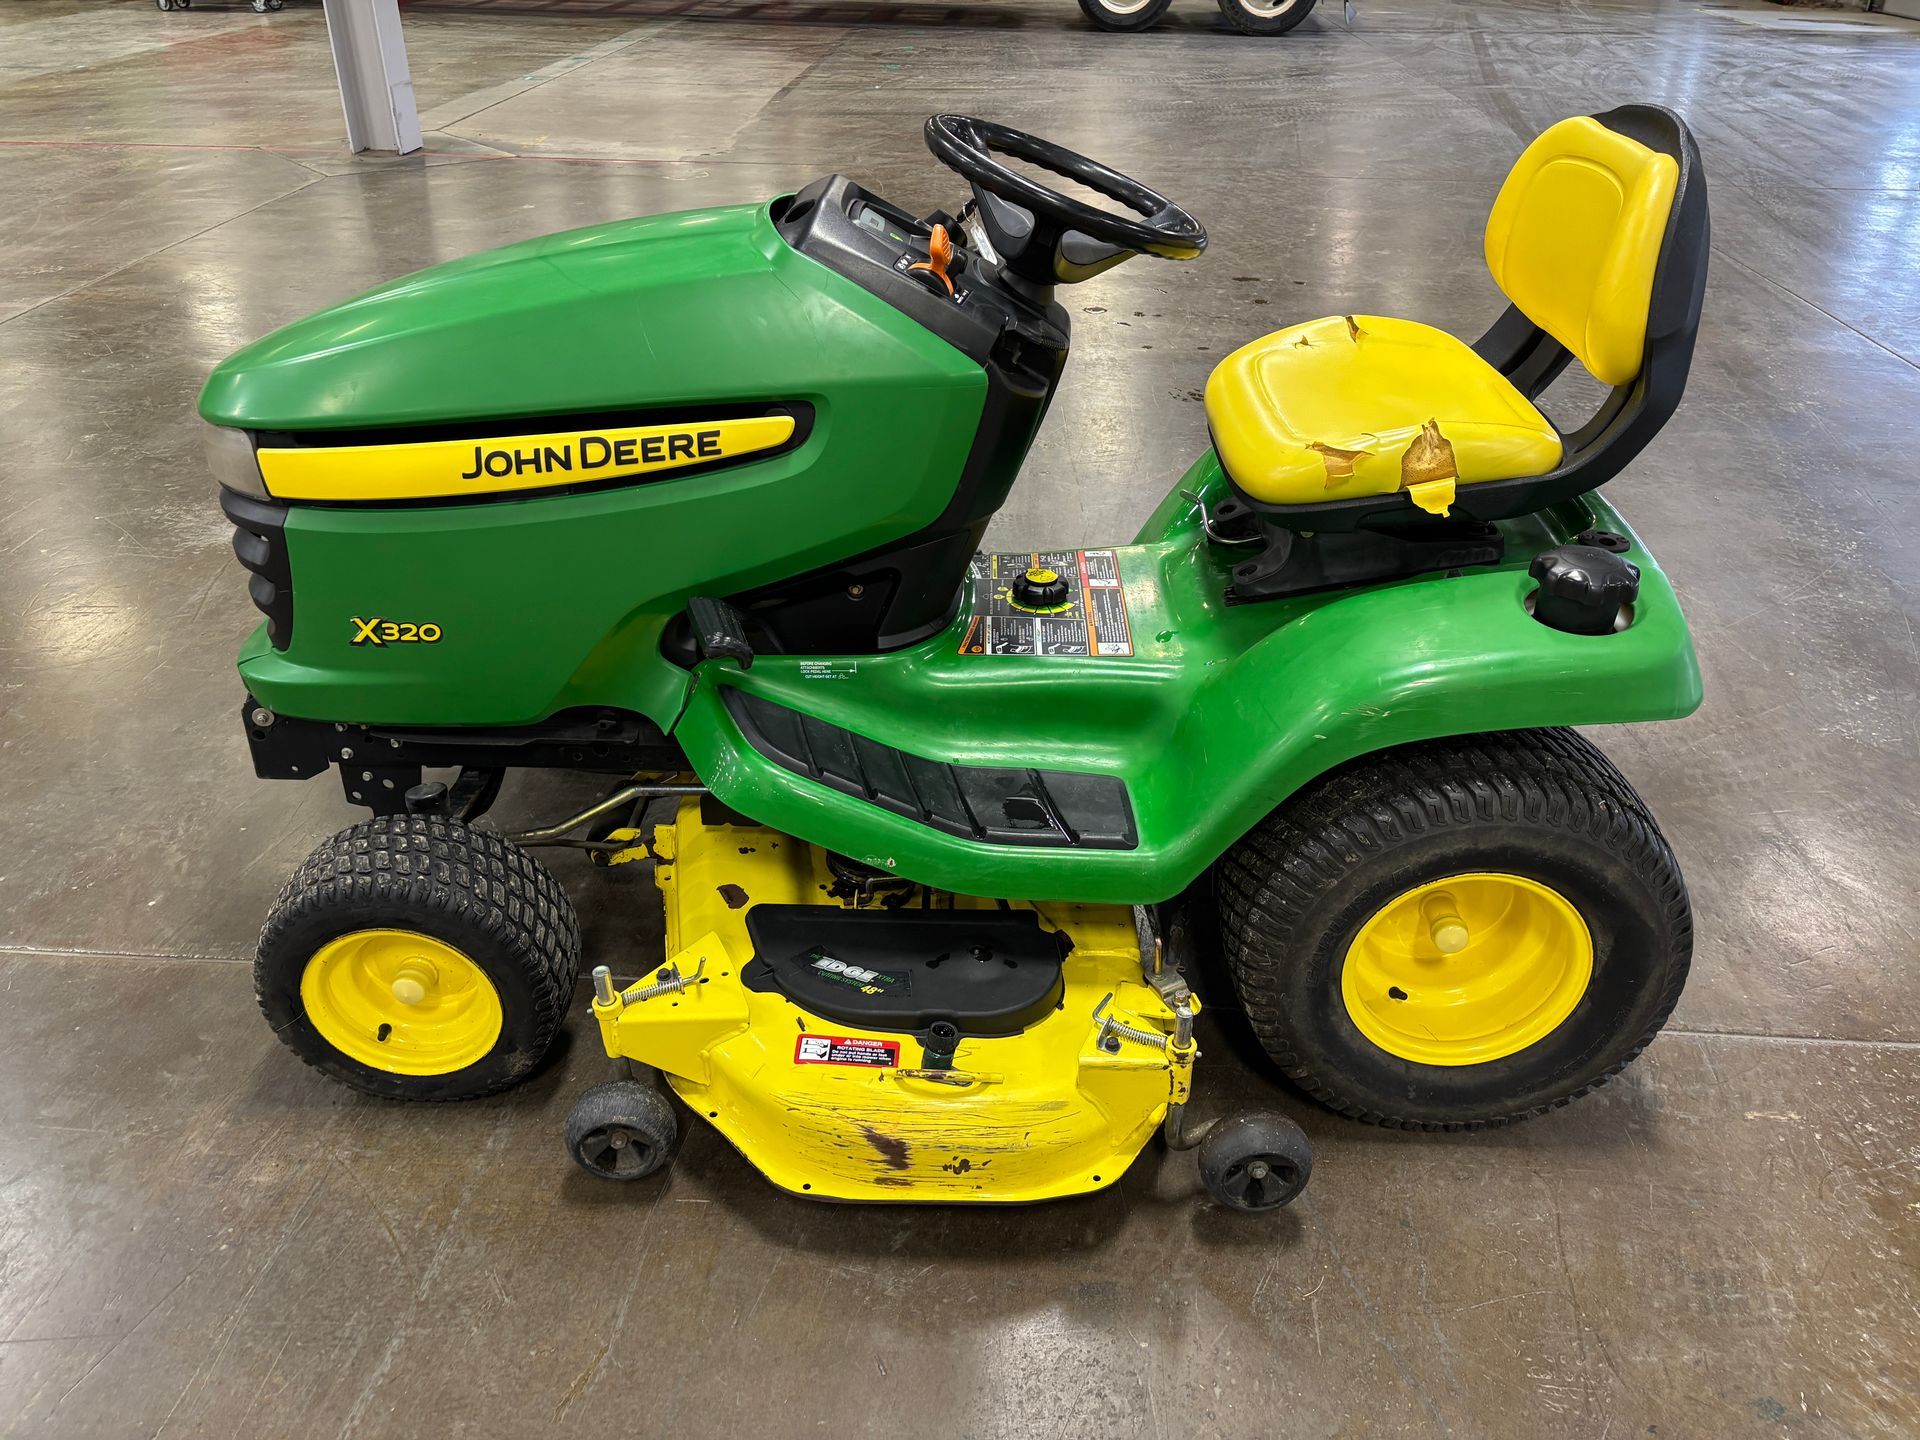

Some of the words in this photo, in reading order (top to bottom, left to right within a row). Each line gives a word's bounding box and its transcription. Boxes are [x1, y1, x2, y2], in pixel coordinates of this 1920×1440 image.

[461, 444, 573, 480] JOHN
[579, 429, 723, 470] DEERE
[349, 615, 444, 647] X320
[810, 956, 880, 983] EDGE
[840, 977, 866, 988] SYSTEM
